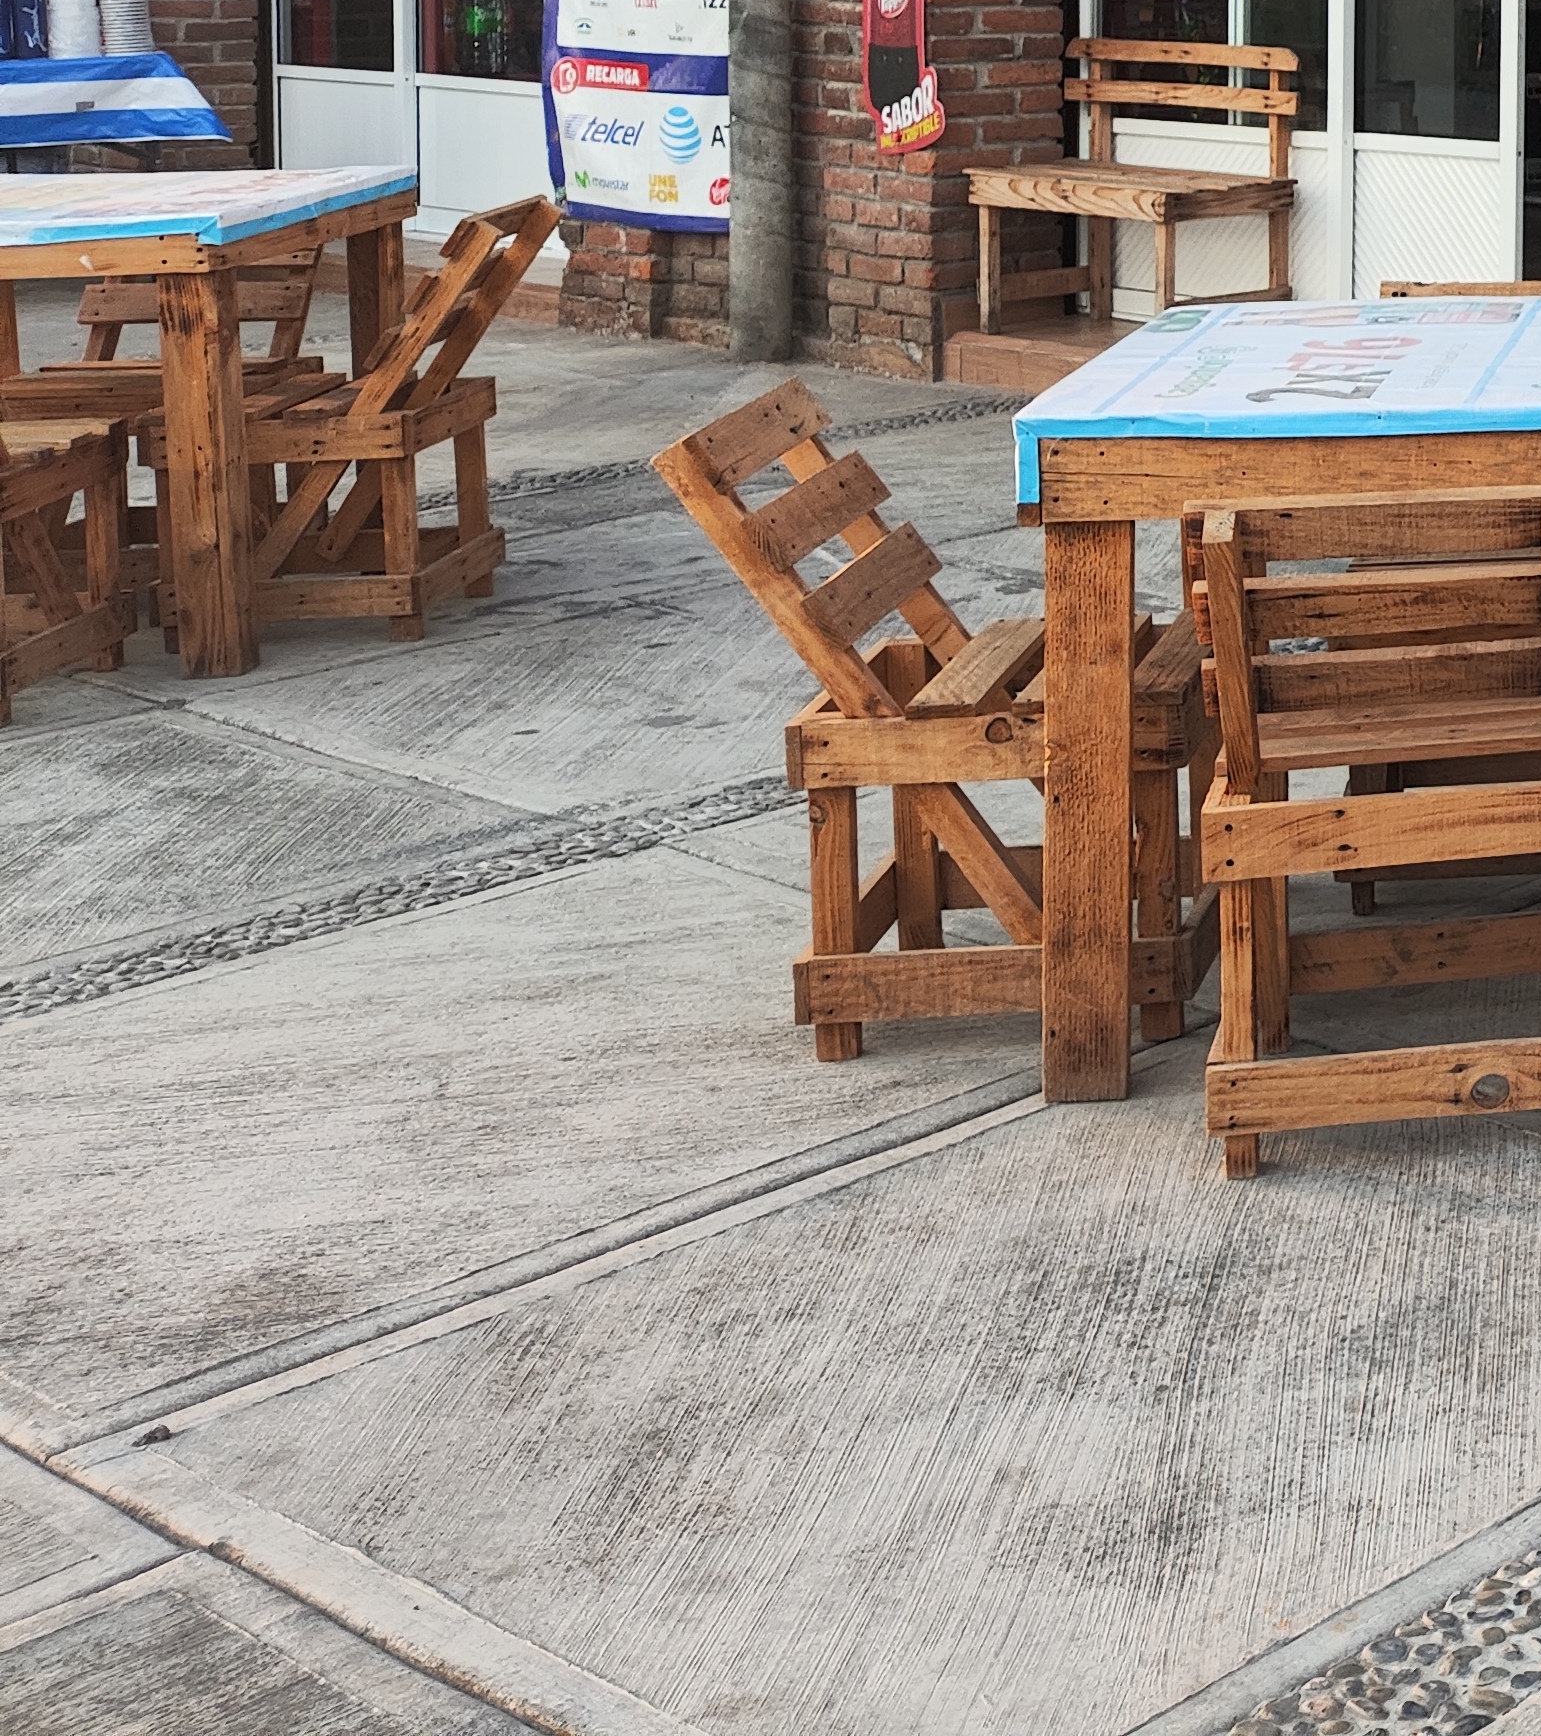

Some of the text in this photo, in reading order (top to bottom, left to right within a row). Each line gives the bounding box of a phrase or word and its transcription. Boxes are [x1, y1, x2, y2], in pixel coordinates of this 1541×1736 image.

[585, 64, 641, 87] RECARGA
[881, 74, 934, 135] SABOR
[581, 116, 645, 147] telcel
